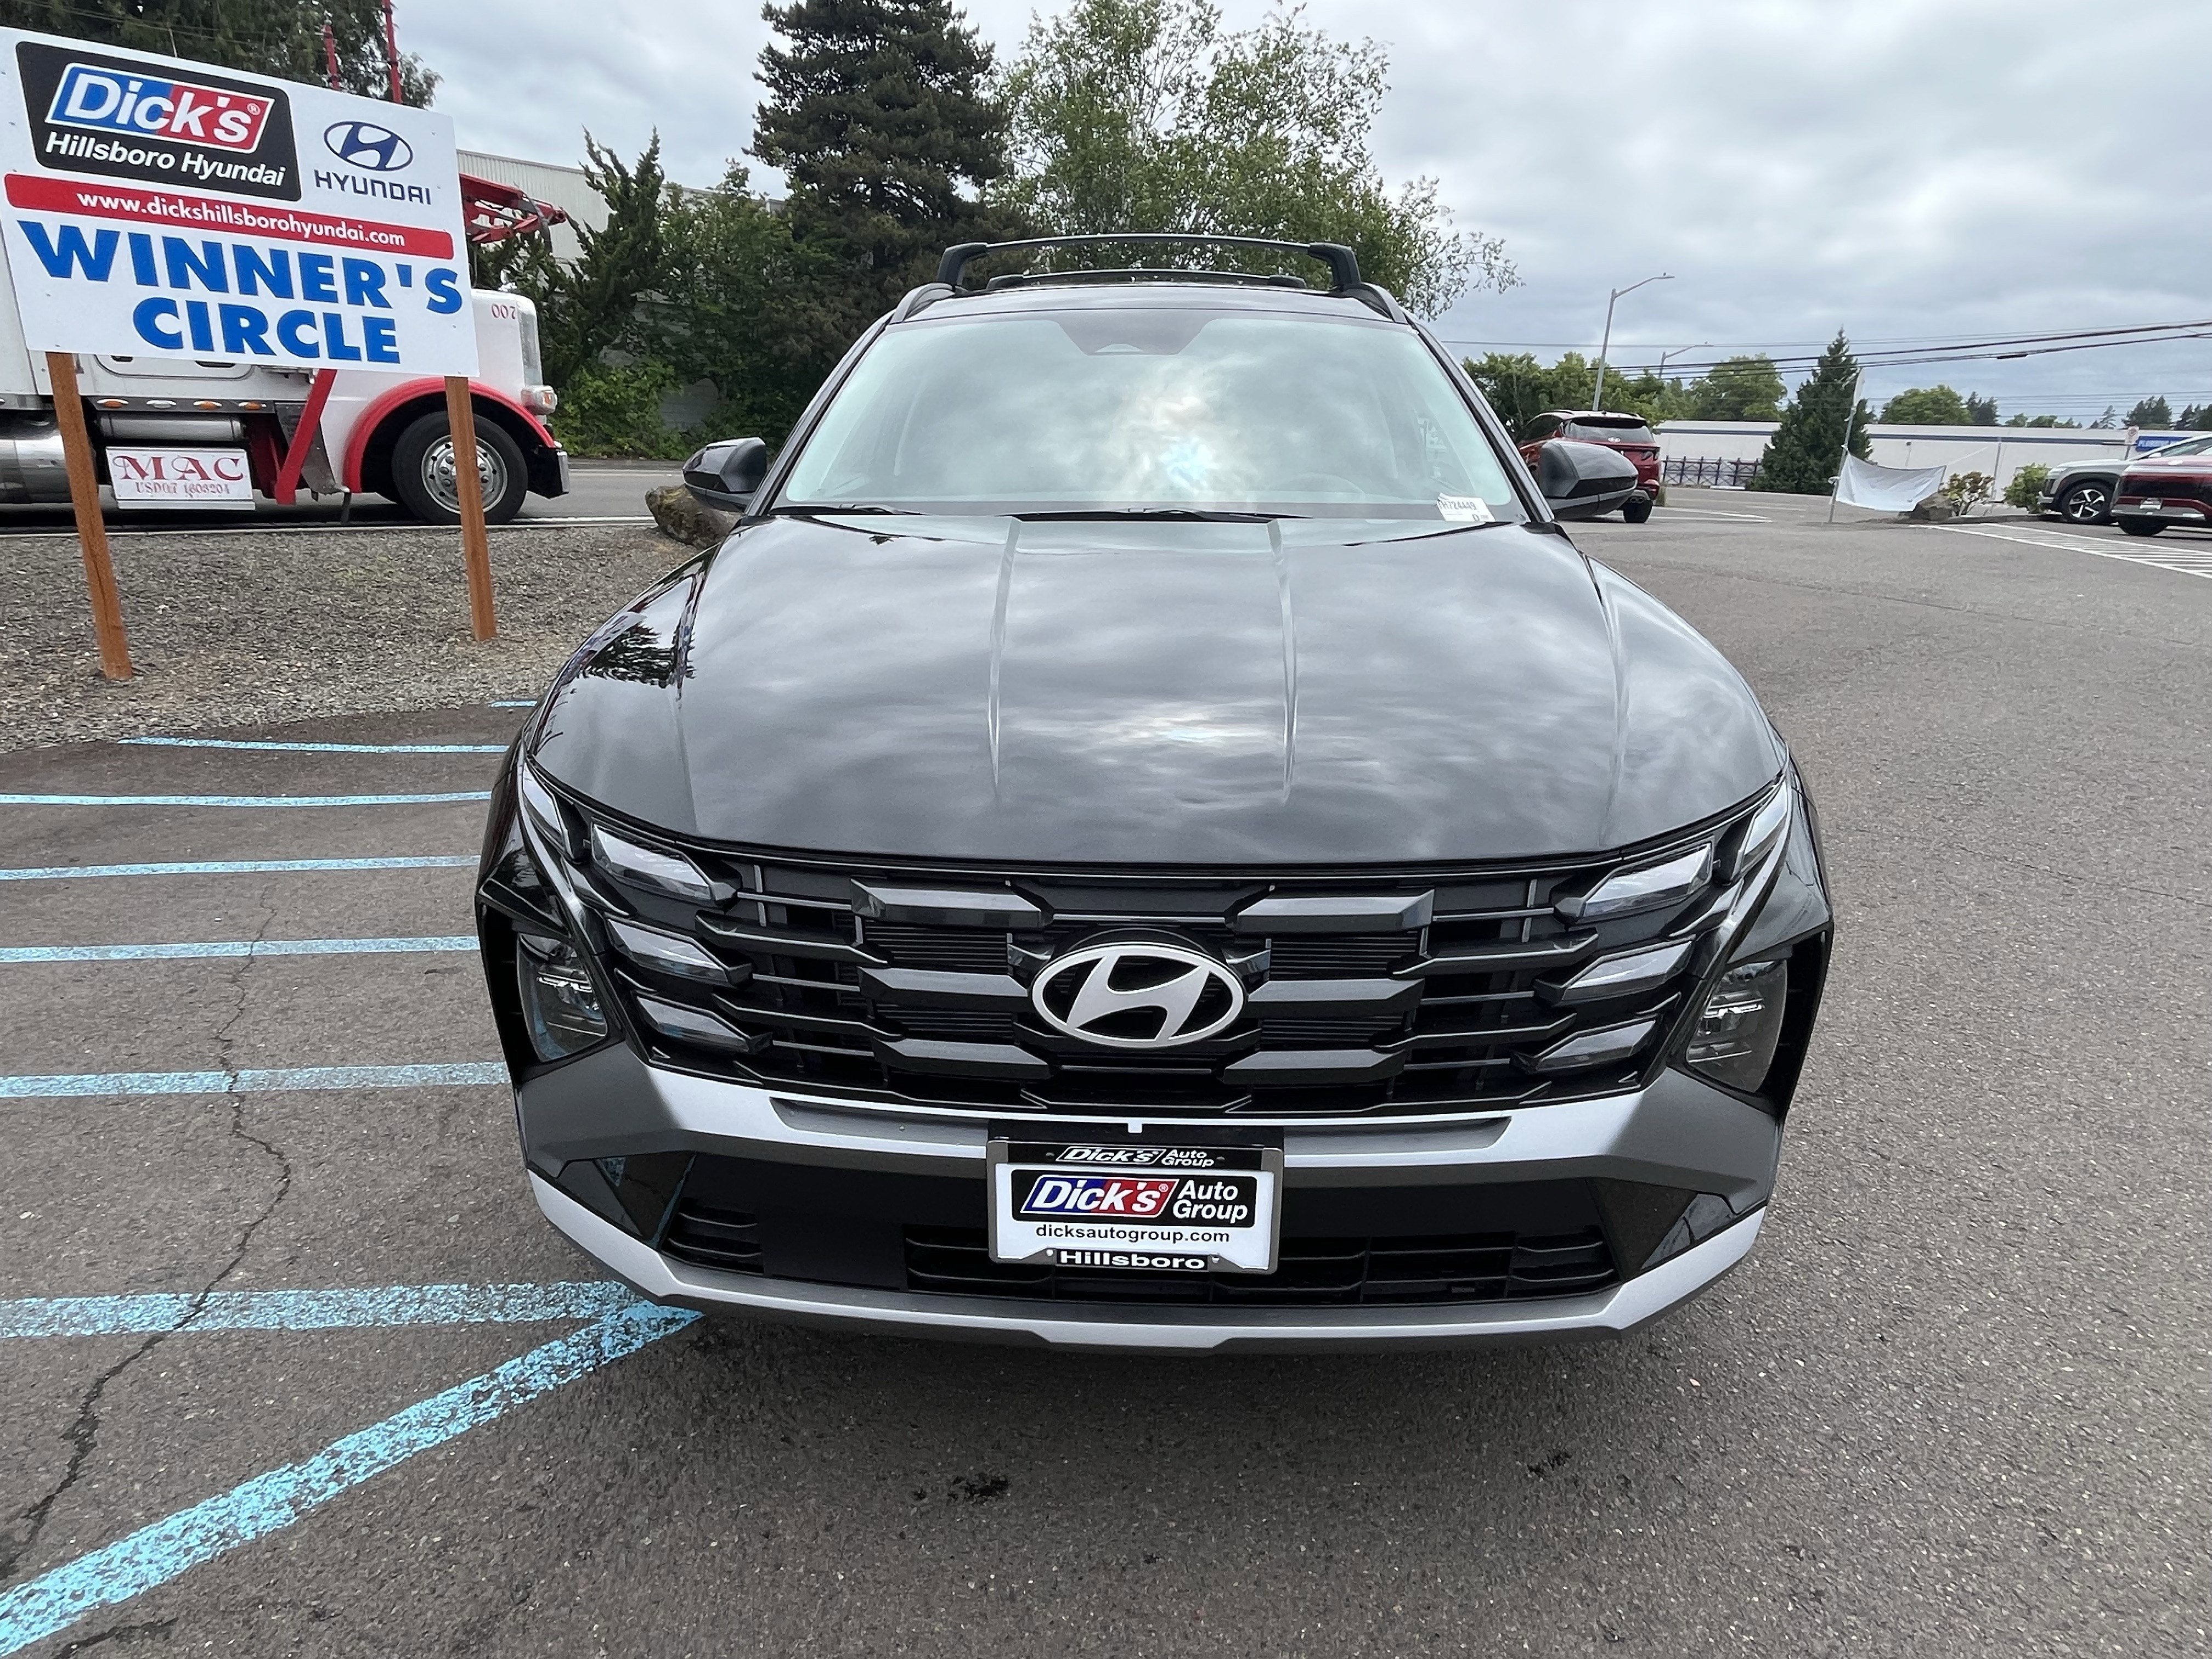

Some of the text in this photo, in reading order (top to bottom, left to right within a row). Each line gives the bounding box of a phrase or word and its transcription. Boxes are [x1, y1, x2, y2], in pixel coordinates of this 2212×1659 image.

[65, 72, 252, 143] Dick's
[45, 131, 286, 187] Hillsboro Hyundai
[314, 168, 431, 206] HYUNDAI
[77, 192, 405, 247] www.dickshillsborohyundai.com
[17, 220, 463, 315] WINNER'S
[491, 303, 516, 319] 007
[133, 297, 401, 364] CIRCLE
[112, 455, 244, 481] MAC
[1064, 1148, 1153, 1163] Dick's
[1161, 1157, 1214, 1167] Group
[1169, 1149, 1207, 1158] Auto
[1031, 1179, 1160, 1212] Dick's
[1177, 1180, 1238, 1201] Auto
[1172, 1199, 1248, 1223] Group
[1036, 1224, 1229, 1243] dicksautogroup.com
[1060, 1250, 1205, 1269] Hillsboro
